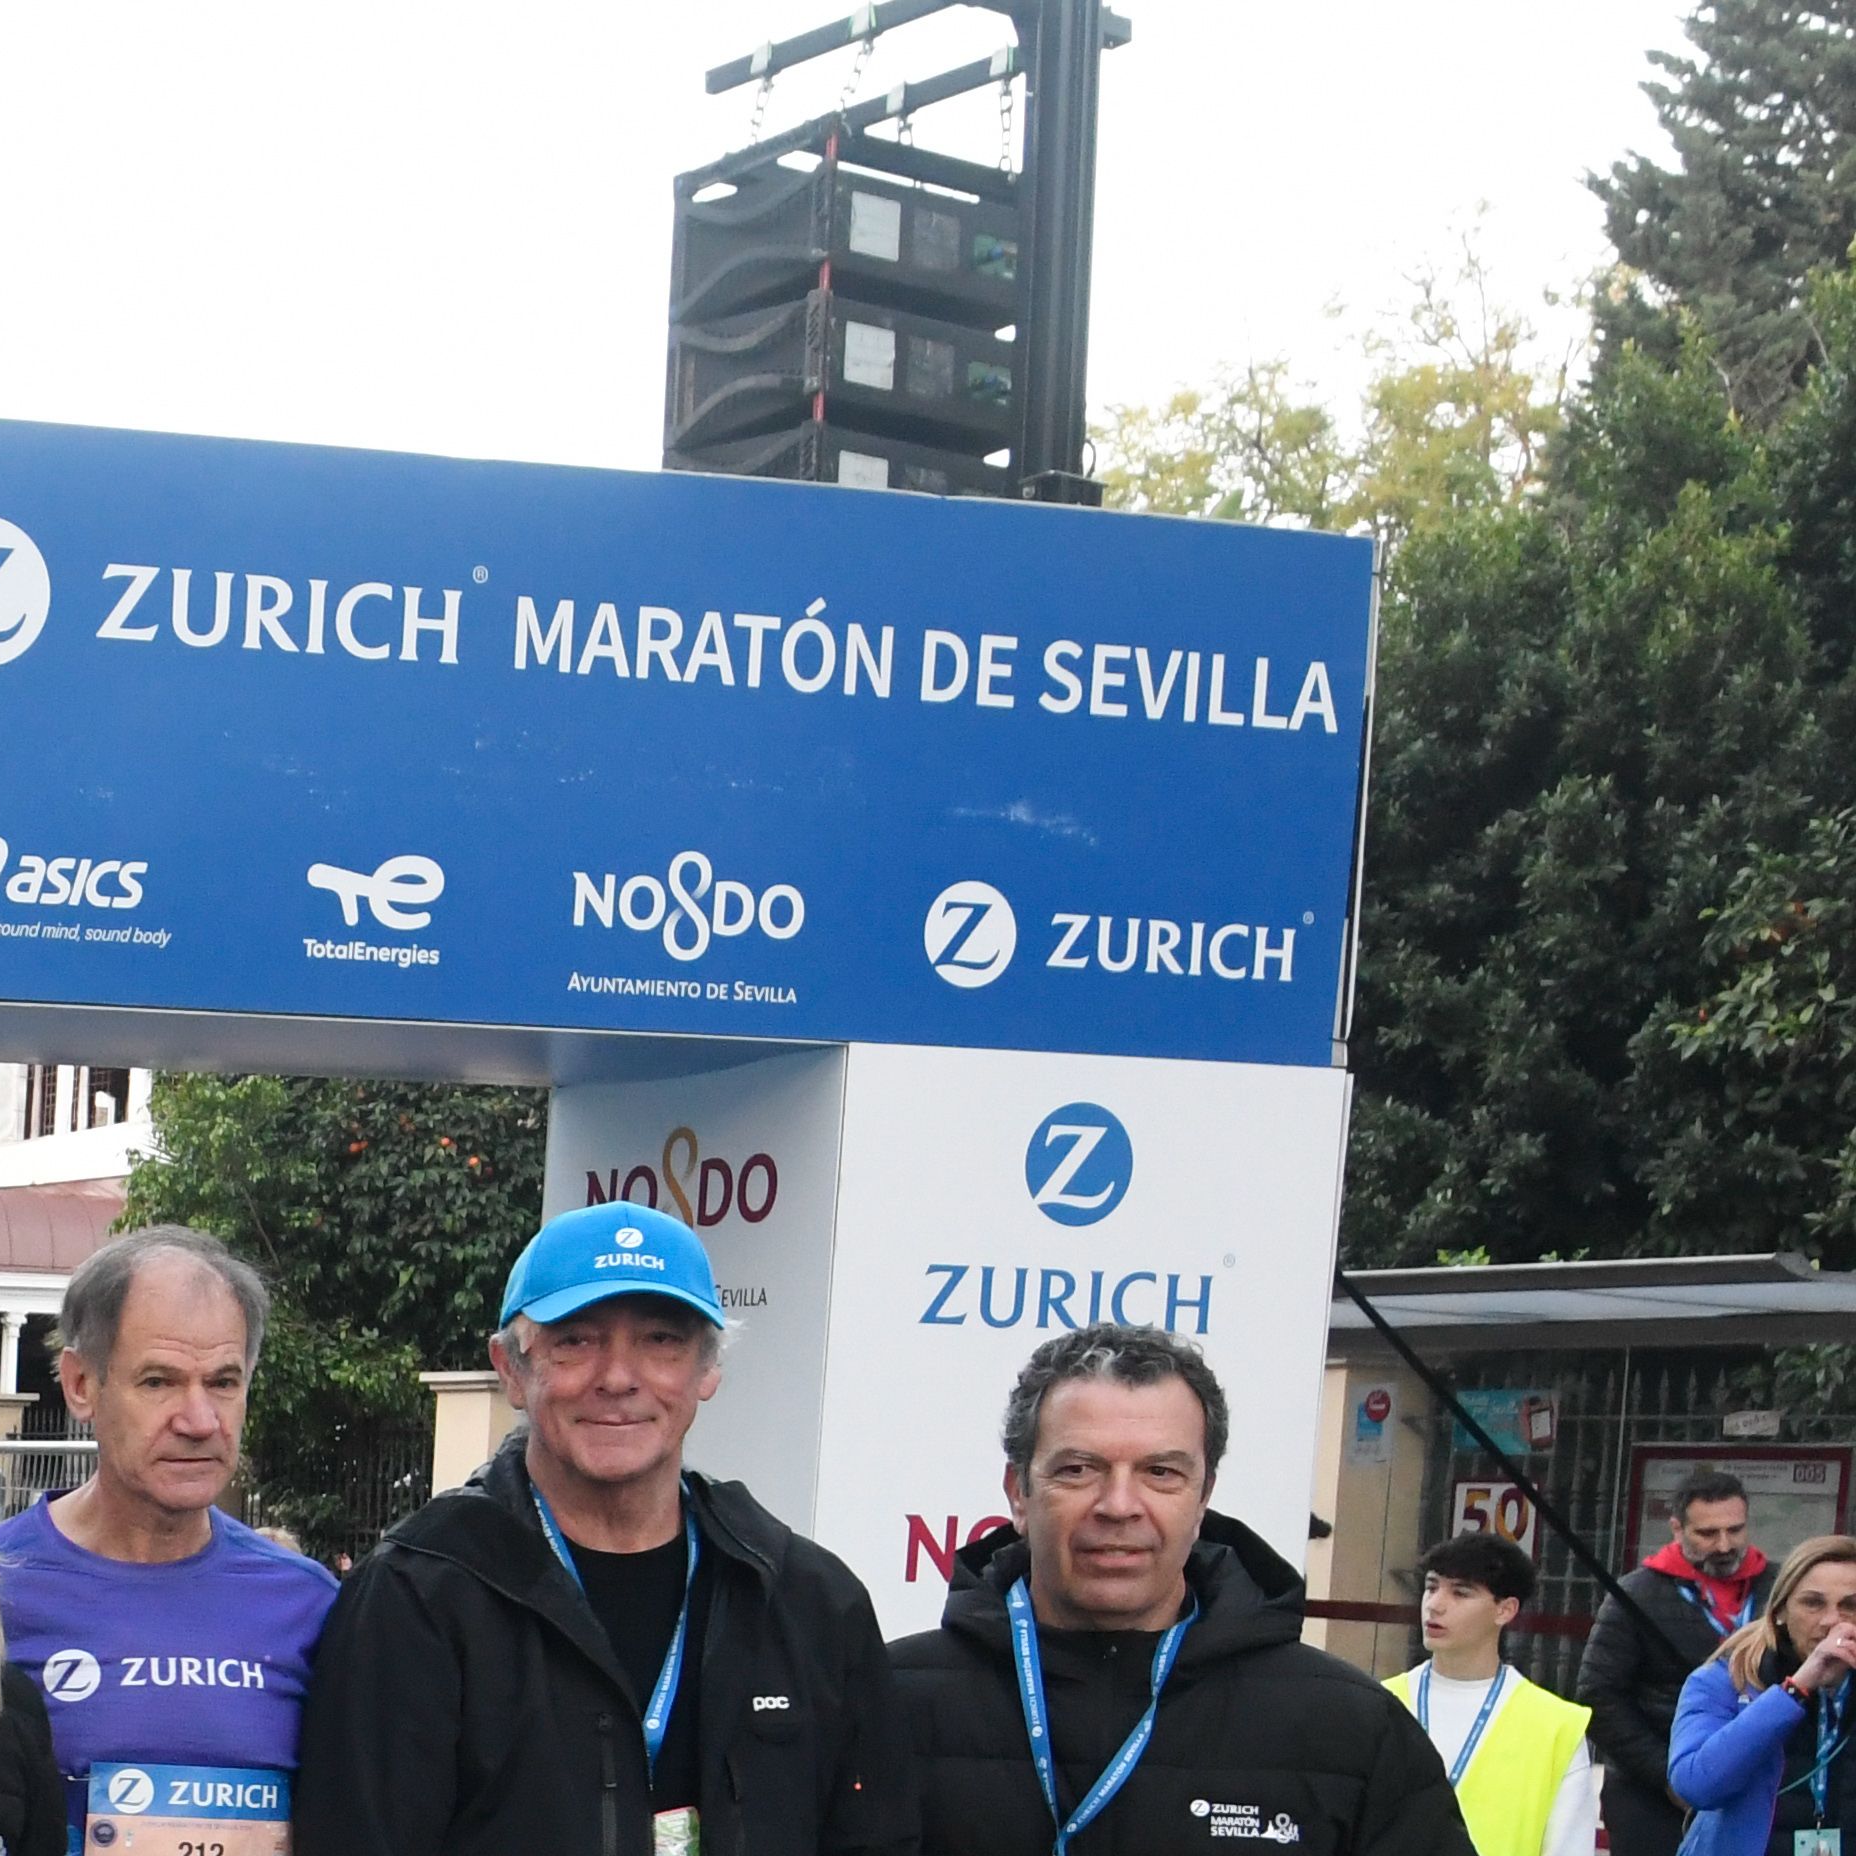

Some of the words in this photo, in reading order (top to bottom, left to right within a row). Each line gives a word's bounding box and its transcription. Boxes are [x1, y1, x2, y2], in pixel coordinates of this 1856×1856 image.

[96, 563, 463, 666] ZURICH
[513, 597, 892, 699] MARATÓN
[920, 628, 1019, 709] DE
[1039, 639, 1339, 735] SEVILLA
[6, 855, 149, 909] asics
[42, 922, 81, 943] mind,
[85, 924, 132, 944] sound
[133, 927, 172, 949] body
[1046, 911, 1298, 984] ZURICH
[303, 937, 440, 970] TotalEnergies
[594, 1253, 665, 1271] ZURICH
[918, 1264, 1213, 1335] ZURICH
[120, 1656, 265, 1689] ZURICH
[168, 1780, 278, 1809] ZURICH
[1212, 1803, 1259, 1815] ZURICH
[1210, 1815, 1260, 1828] MARATÓN
[1210, 1826, 1261, 1838] SEVILLA
